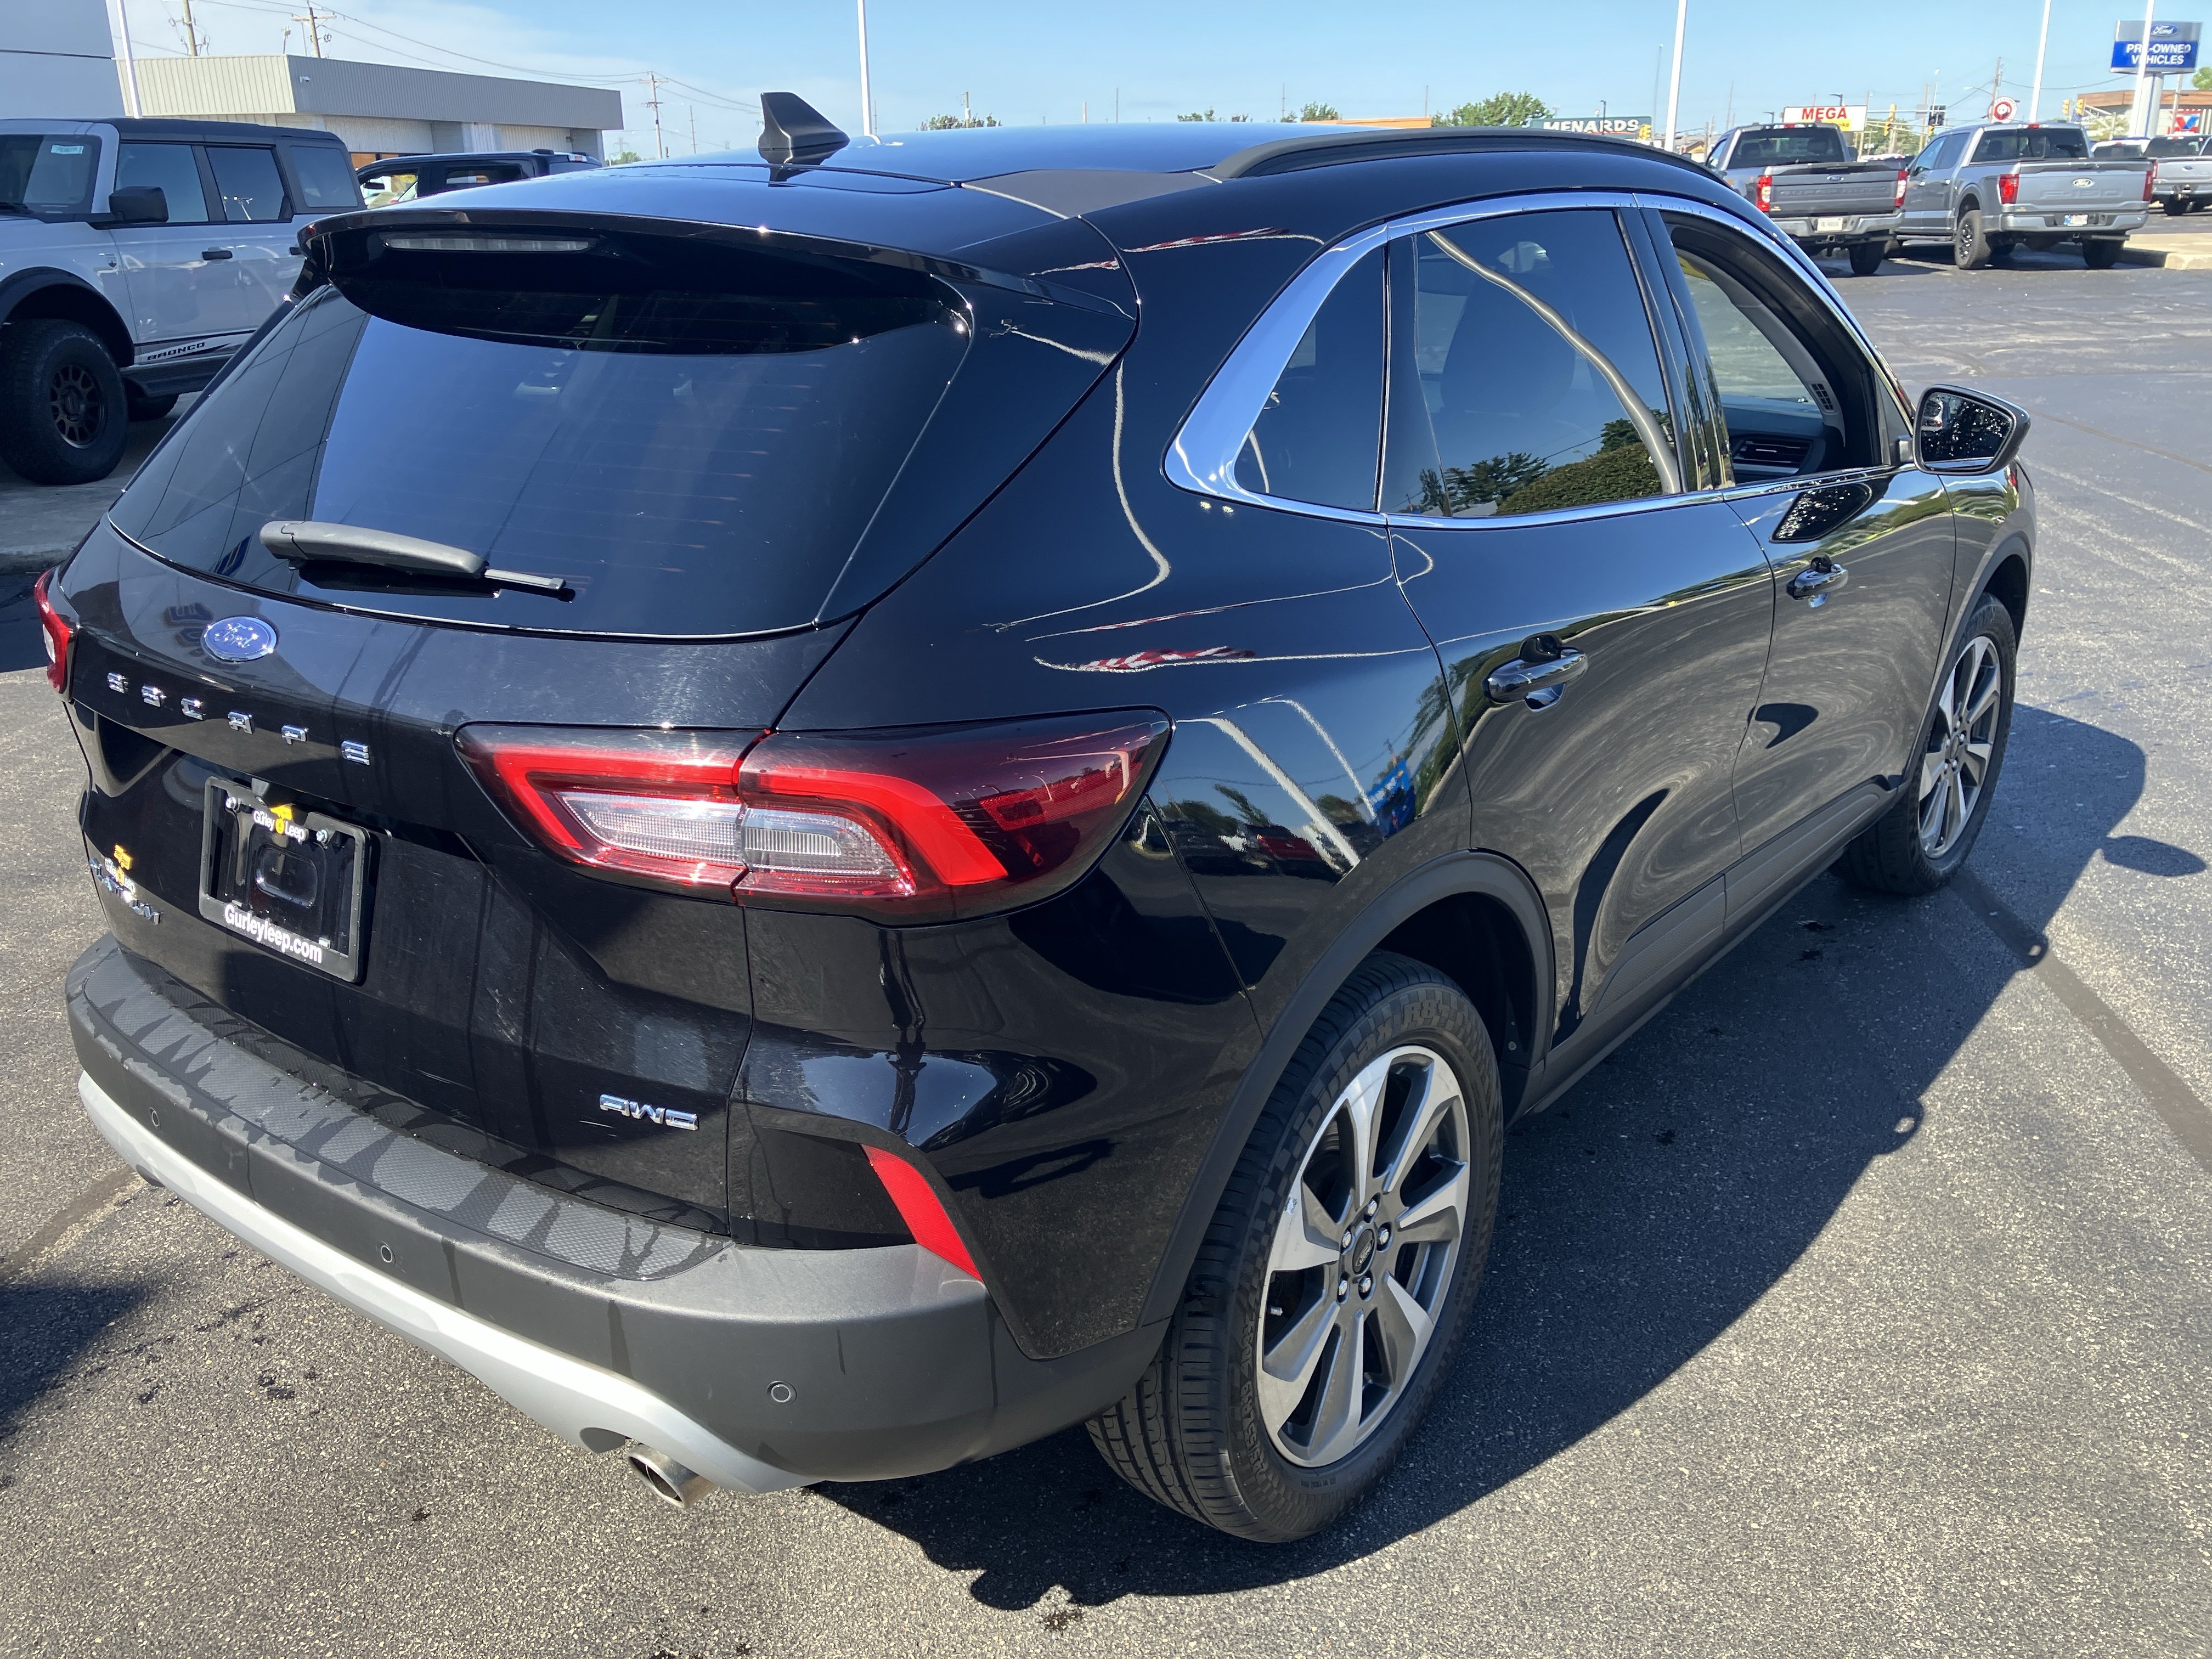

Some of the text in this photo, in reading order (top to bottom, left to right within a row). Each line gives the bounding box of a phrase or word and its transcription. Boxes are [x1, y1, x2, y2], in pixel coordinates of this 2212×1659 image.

[2153, 25, 2175, 35] Ford
[2126, 43, 2192, 53] PR-OWNED
[2132, 55, 2185, 64] VHICLES
[1801, 107, 1847, 120] MEGA
[1543, 119, 1639, 132] MENARDS
[146, 342, 205, 360] BRONCO
[107, 672, 370, 766] ESCAPE
[253, 810, 275, 832] Gurley
[285, 821, 305, 844] Leep
[225, 904, 322, 964] Gurleyleep.com
[599, 1094, 698, 1131] AWD
